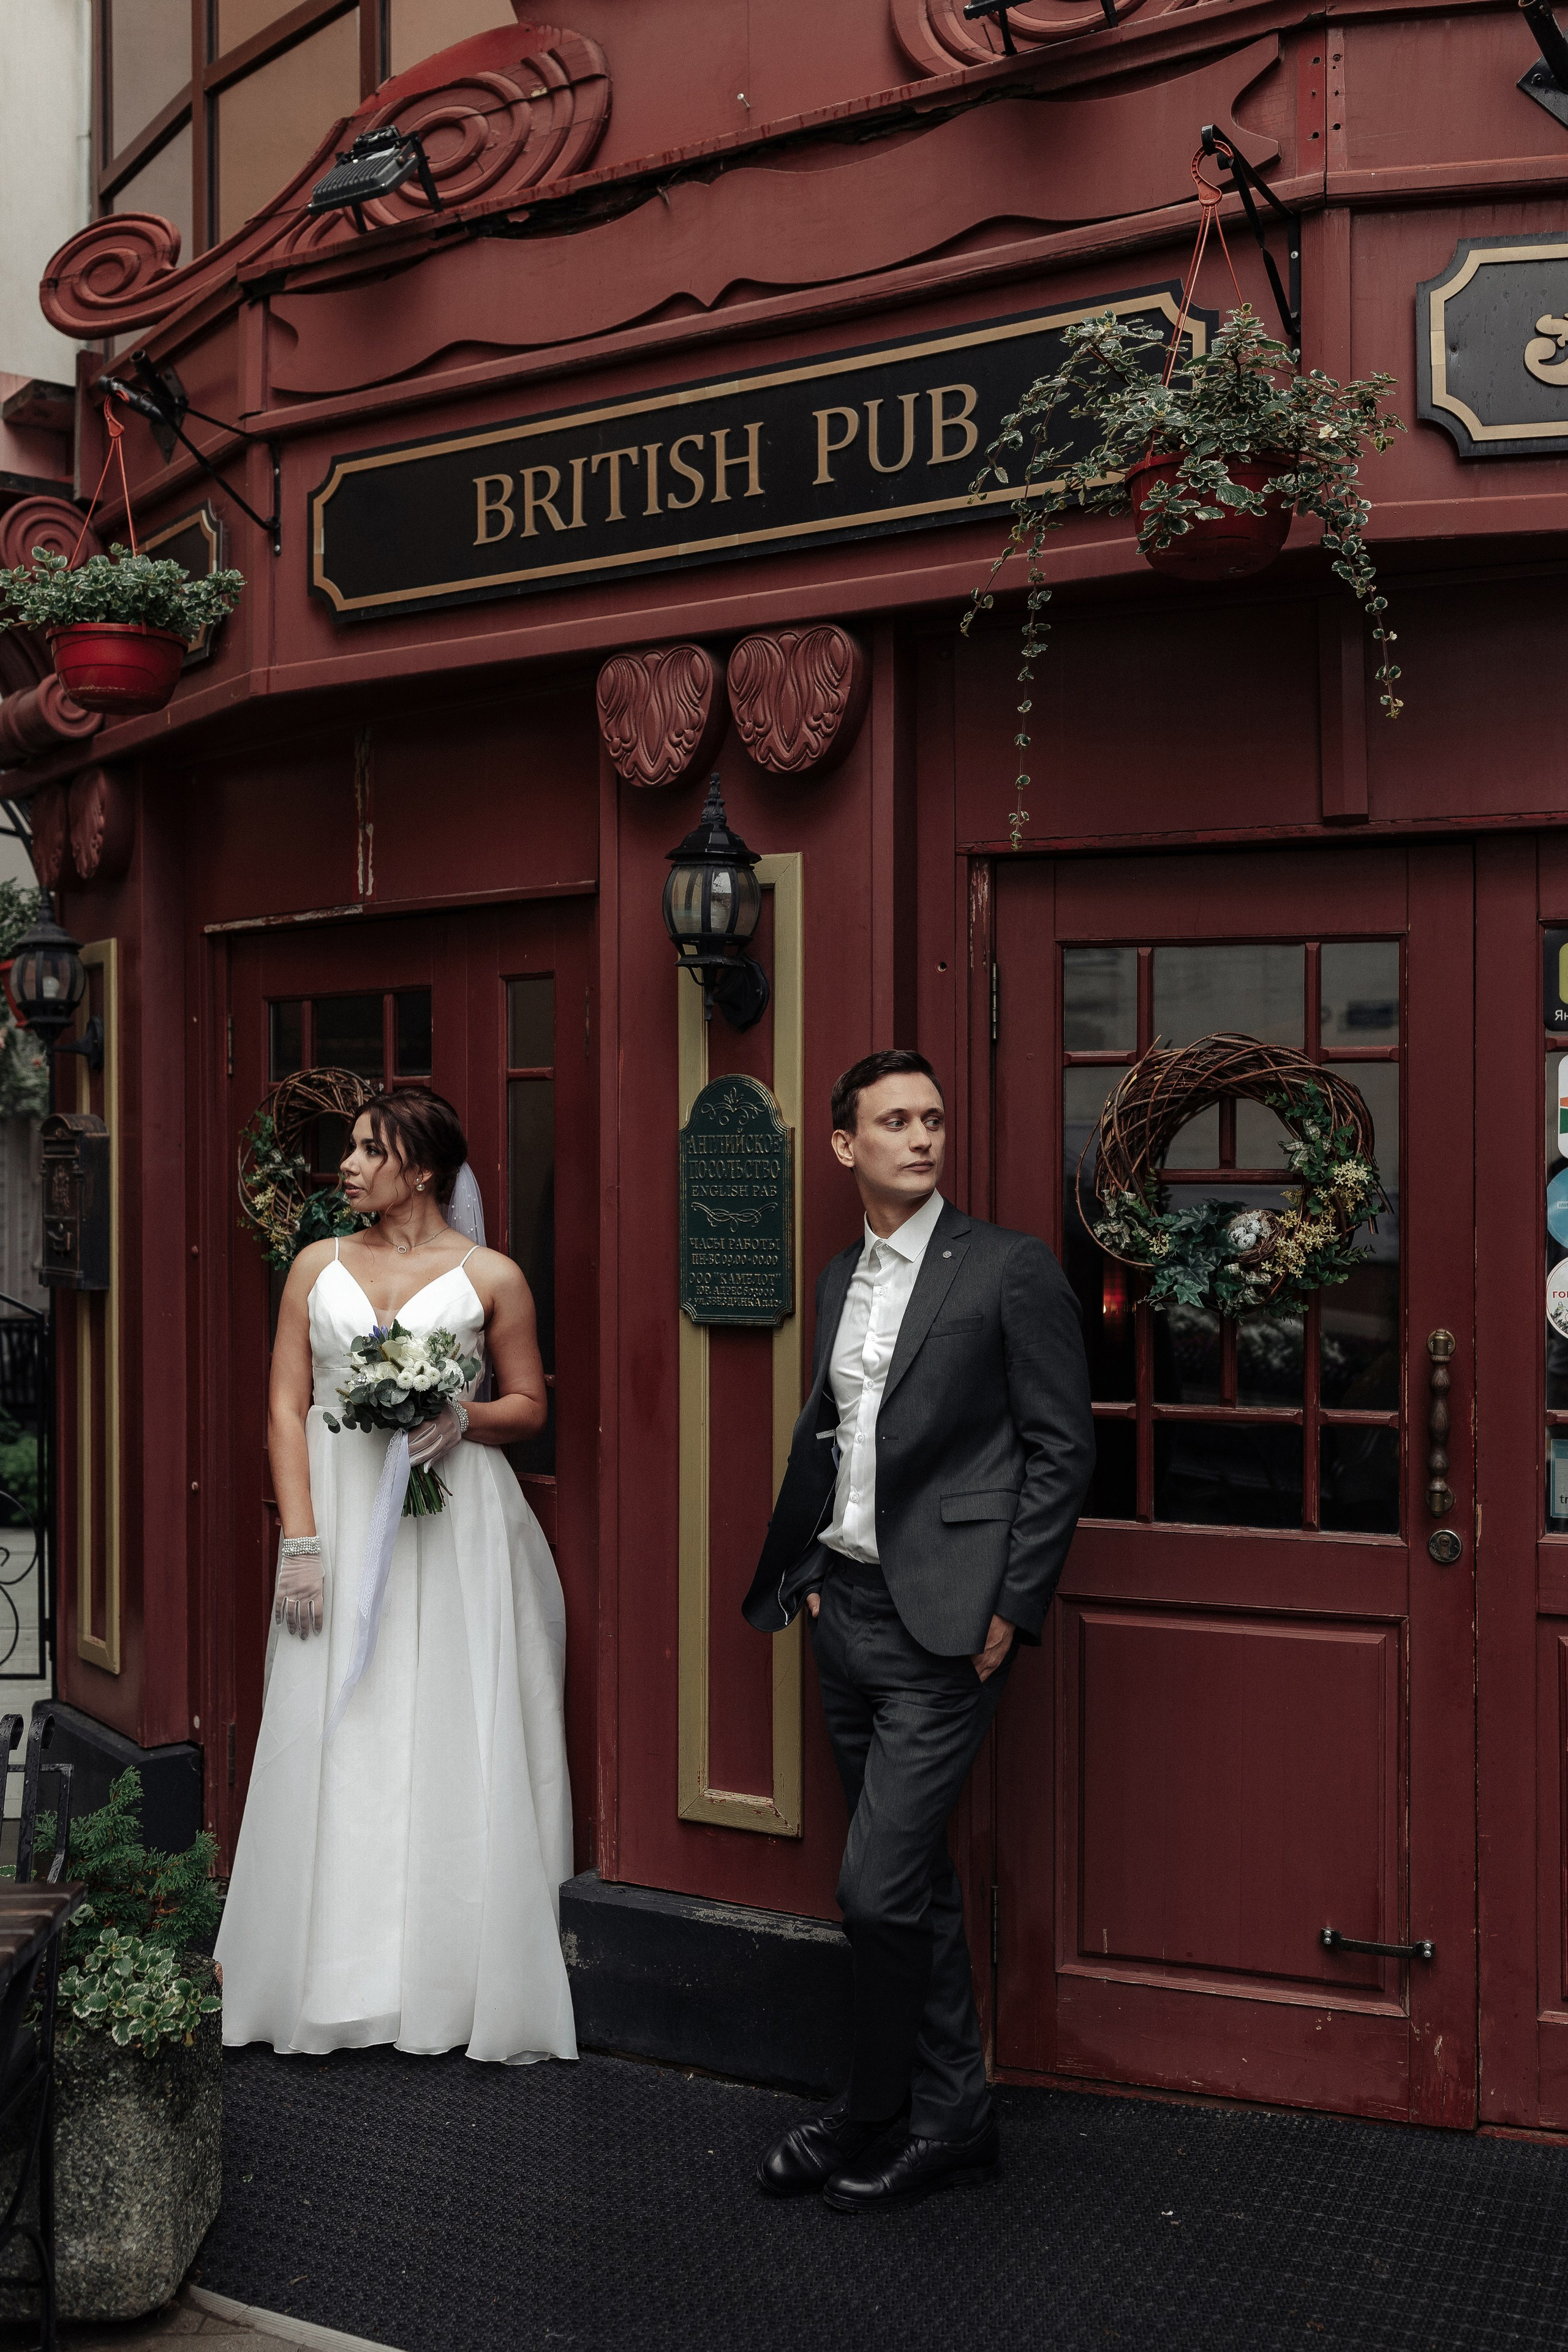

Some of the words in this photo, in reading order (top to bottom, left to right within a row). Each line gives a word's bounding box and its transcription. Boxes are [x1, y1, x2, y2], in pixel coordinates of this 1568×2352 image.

[472, 421, 764, 546] BRITISH
[812, 383, 979, 485] PUB
[687, 1128, 781, 1154] АНГЛИЙСКОЕ
[688, 1159, 780, 1180] ПОСОЛЬСТВО
[691, 1185, 748, 1197] ENGLISH
[689, 1237, 725, 1250] ЧАСЫ
[728, 1238, 780, 1250] РАБОТЫ
[692, 1253, 720, 1265] ПН-ВС
[688, 1272, 711, 1284] ООО
[714, 1272, 782, 1285] "КАМЕЛОТ"
[696, 1286, 711, 1295] ЮР.
[713, 1286, 742, 1295] АДРЕС
